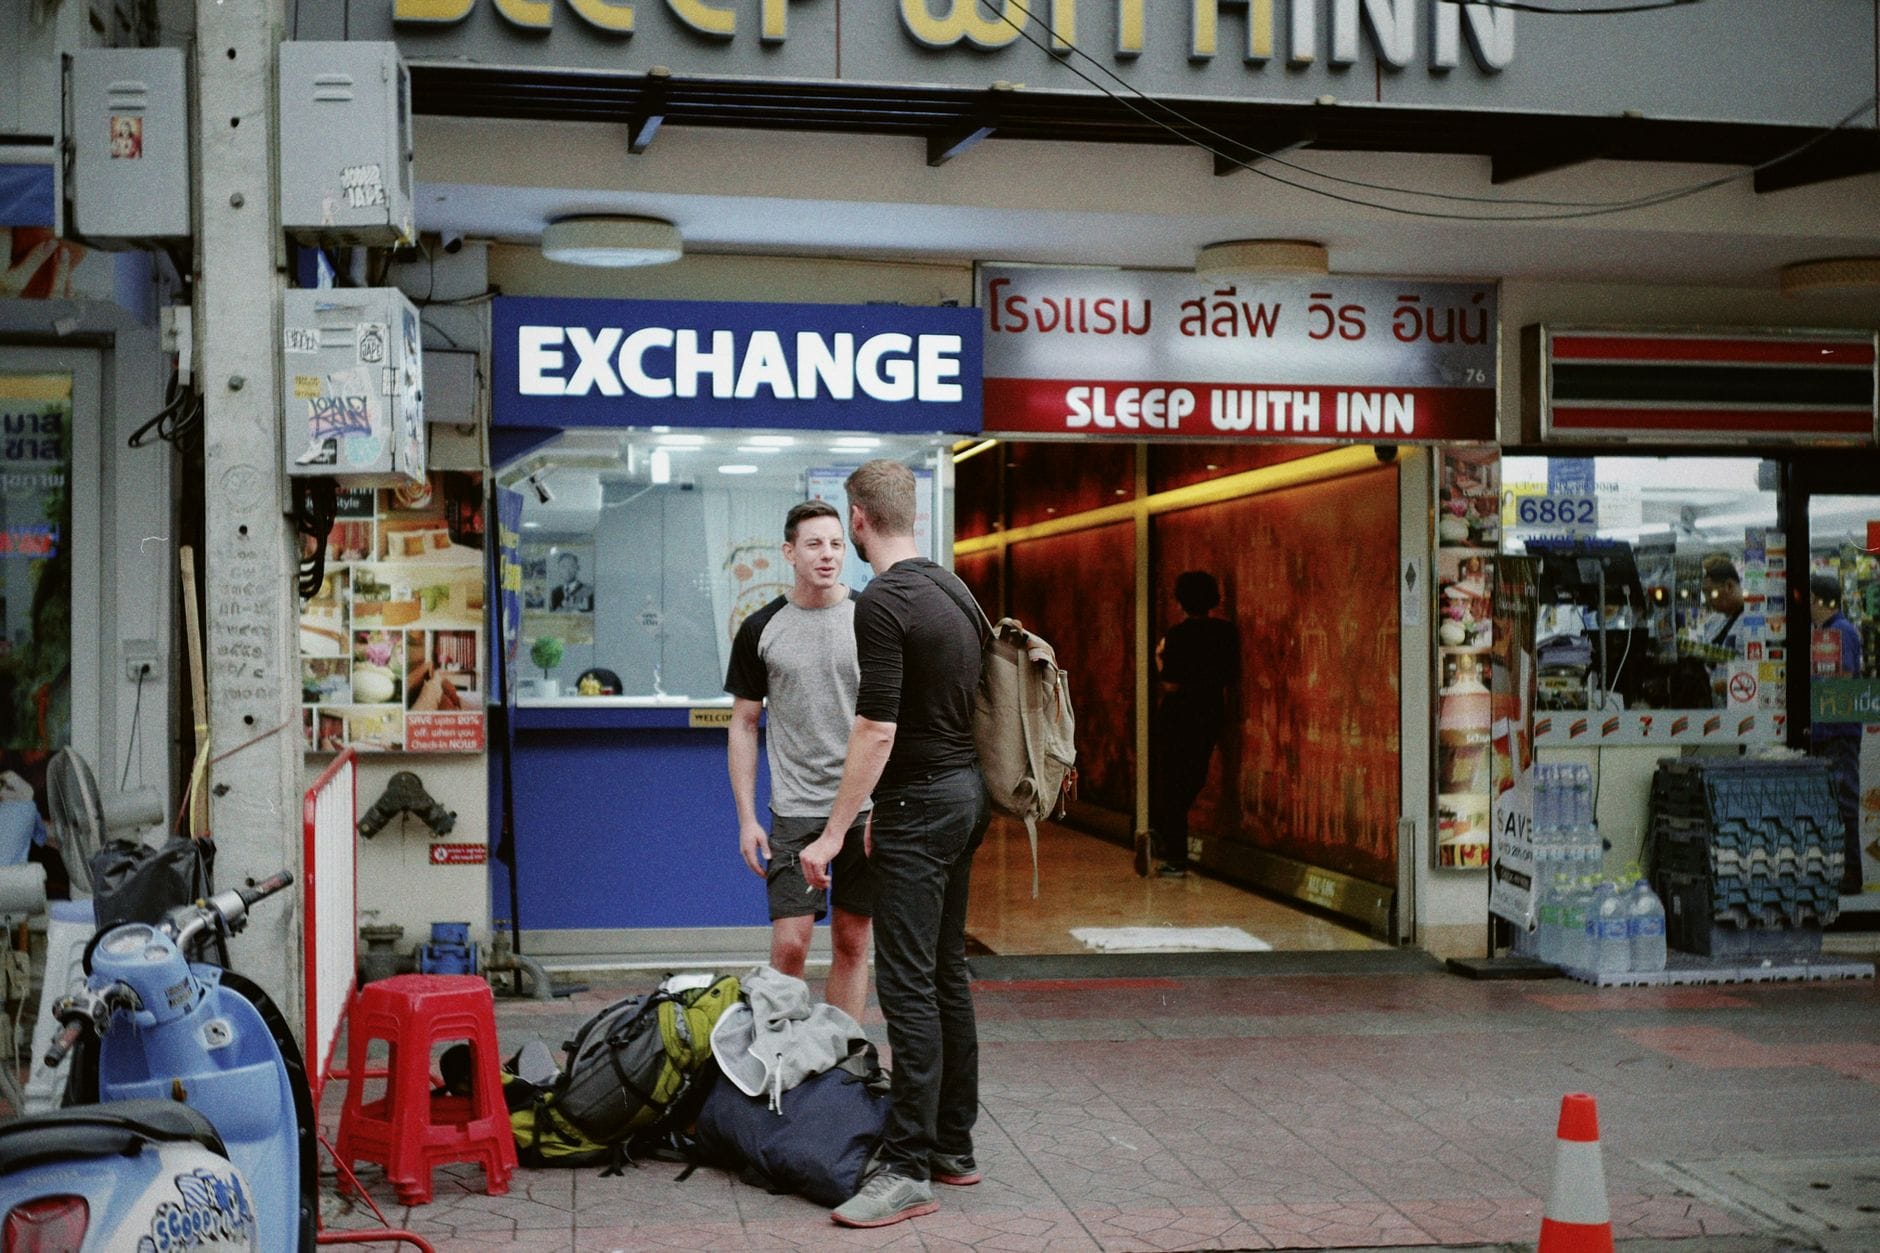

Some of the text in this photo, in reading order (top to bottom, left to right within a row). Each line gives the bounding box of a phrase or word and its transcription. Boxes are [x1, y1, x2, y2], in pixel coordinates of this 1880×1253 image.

[989, 278, 1151, 335] โรงแรม
[1180, 286, 1281, 337] สลีพ
[1308, 293, 1366, 341] วิธ
[519, 325, 963, 402] EXCHANGE
[1466, 369, 1487, 384] 76
[1066, 387, 1415, 434] SLEEP WITH INN
[1520, 498, 1595, 524] 6862
[1496, 808, 1533, 844] SAVE
